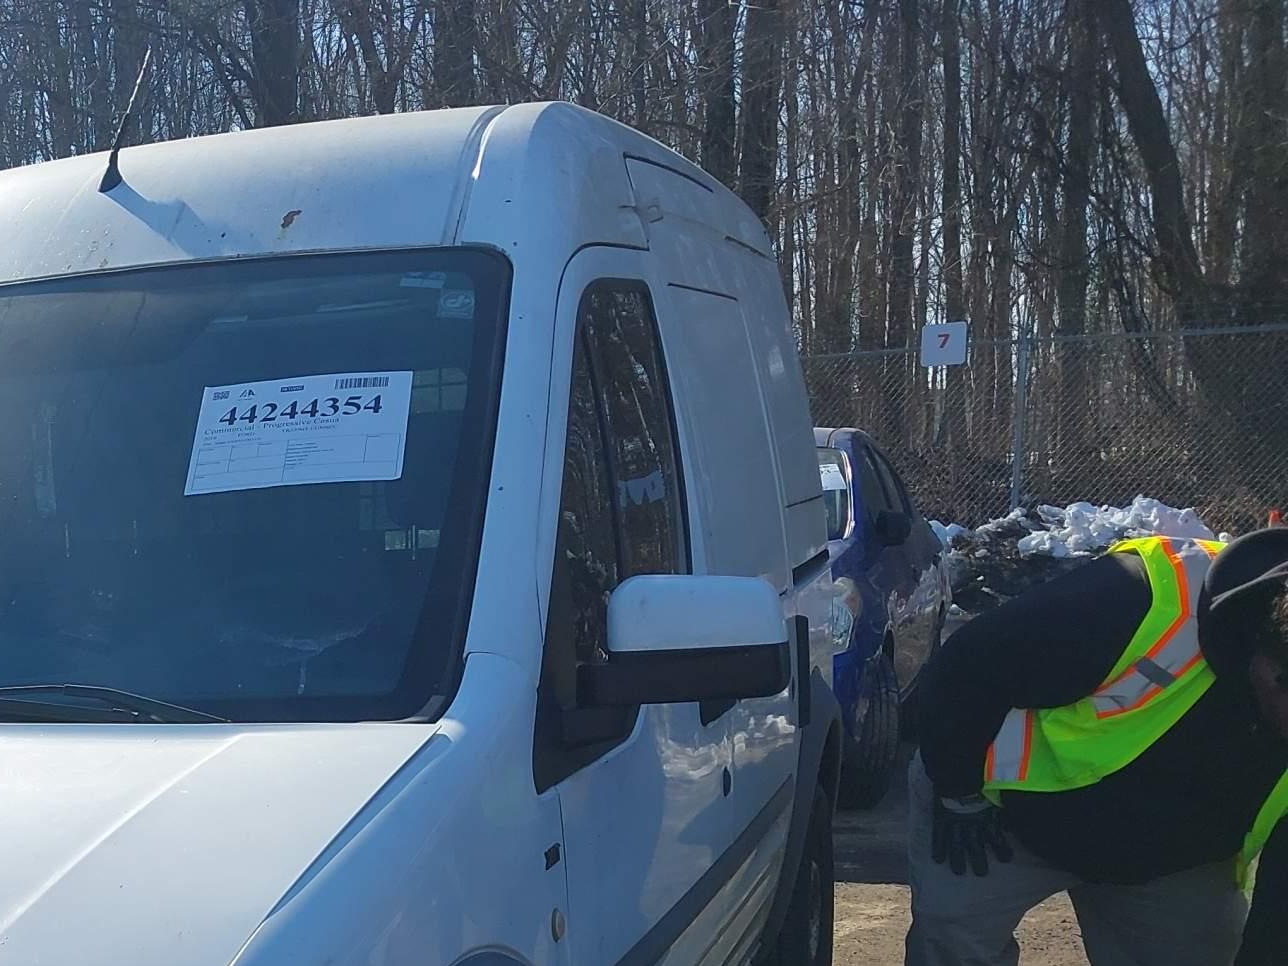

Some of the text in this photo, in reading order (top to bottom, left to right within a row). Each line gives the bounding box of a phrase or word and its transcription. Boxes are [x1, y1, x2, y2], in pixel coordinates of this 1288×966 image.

[937, 333, 950, 348] 7
[219, 394, 383, 426] 44244354
[263, 419, 312, 430] Progressive
